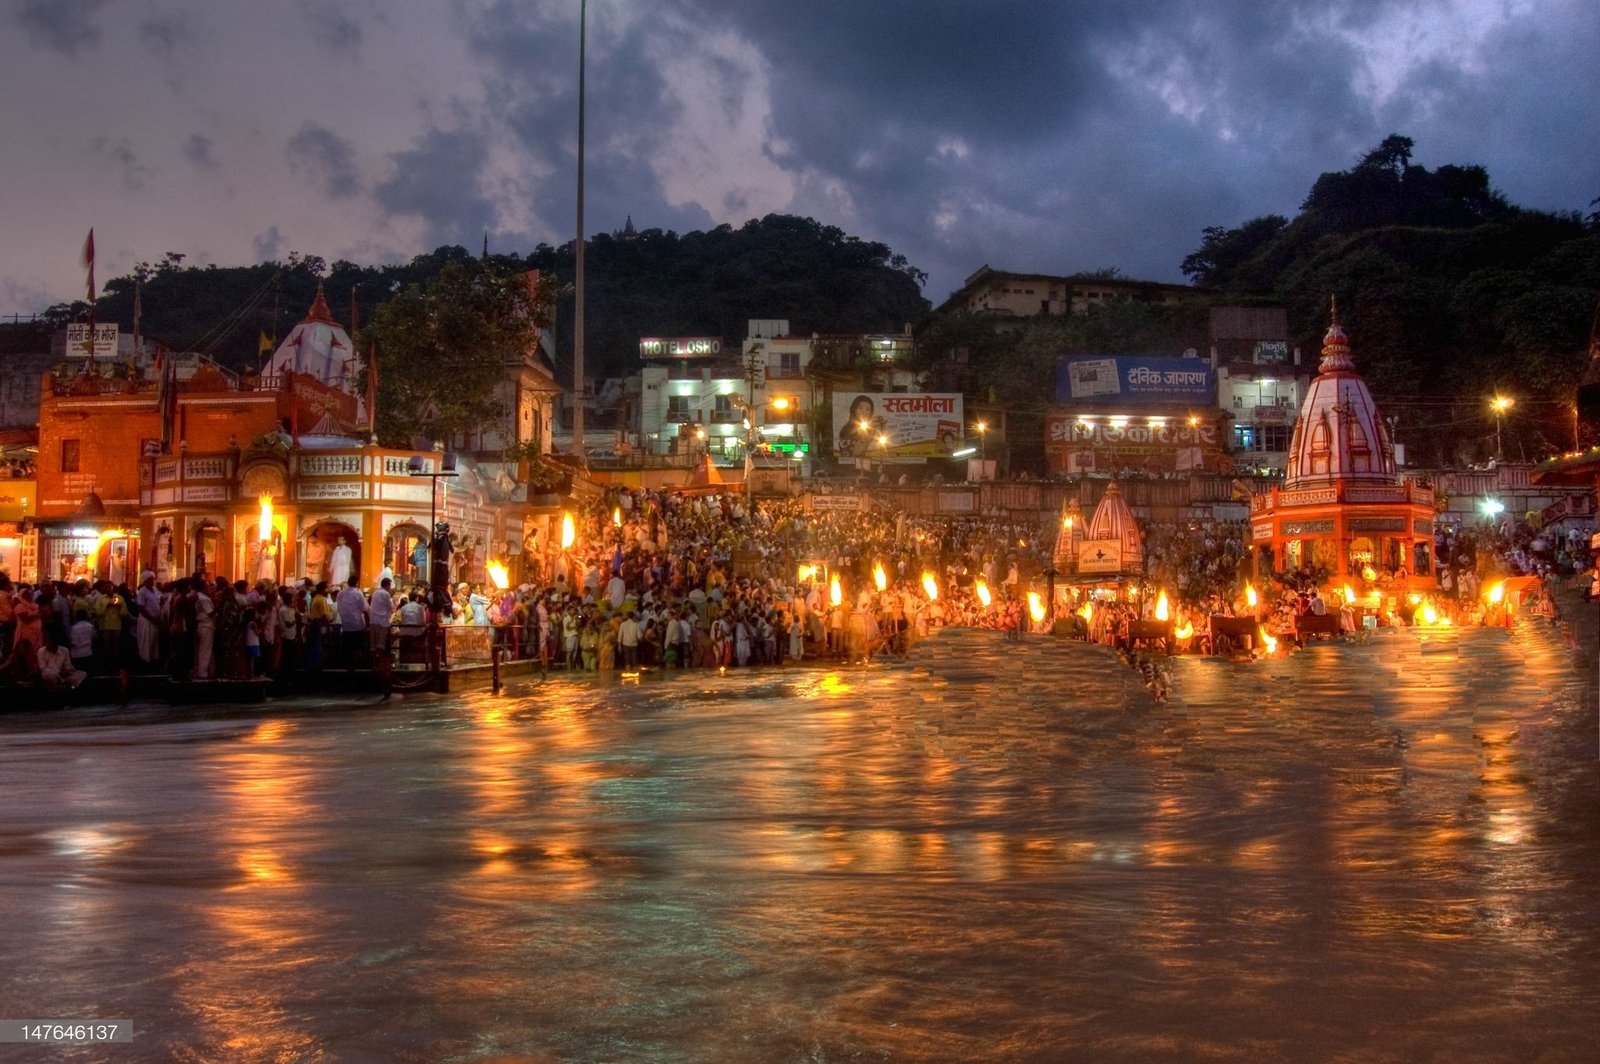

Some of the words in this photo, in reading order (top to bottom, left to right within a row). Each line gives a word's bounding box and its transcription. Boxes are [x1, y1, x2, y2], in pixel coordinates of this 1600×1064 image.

[643, 341, 684, 354] HOTEL
[687, 340, 720, 354] OSHO
[1128, 367, 1161, 385] दैनिक
[1164, 371, 1207, 386] जागरण
[882, 395, 955, 413] सतमोला
